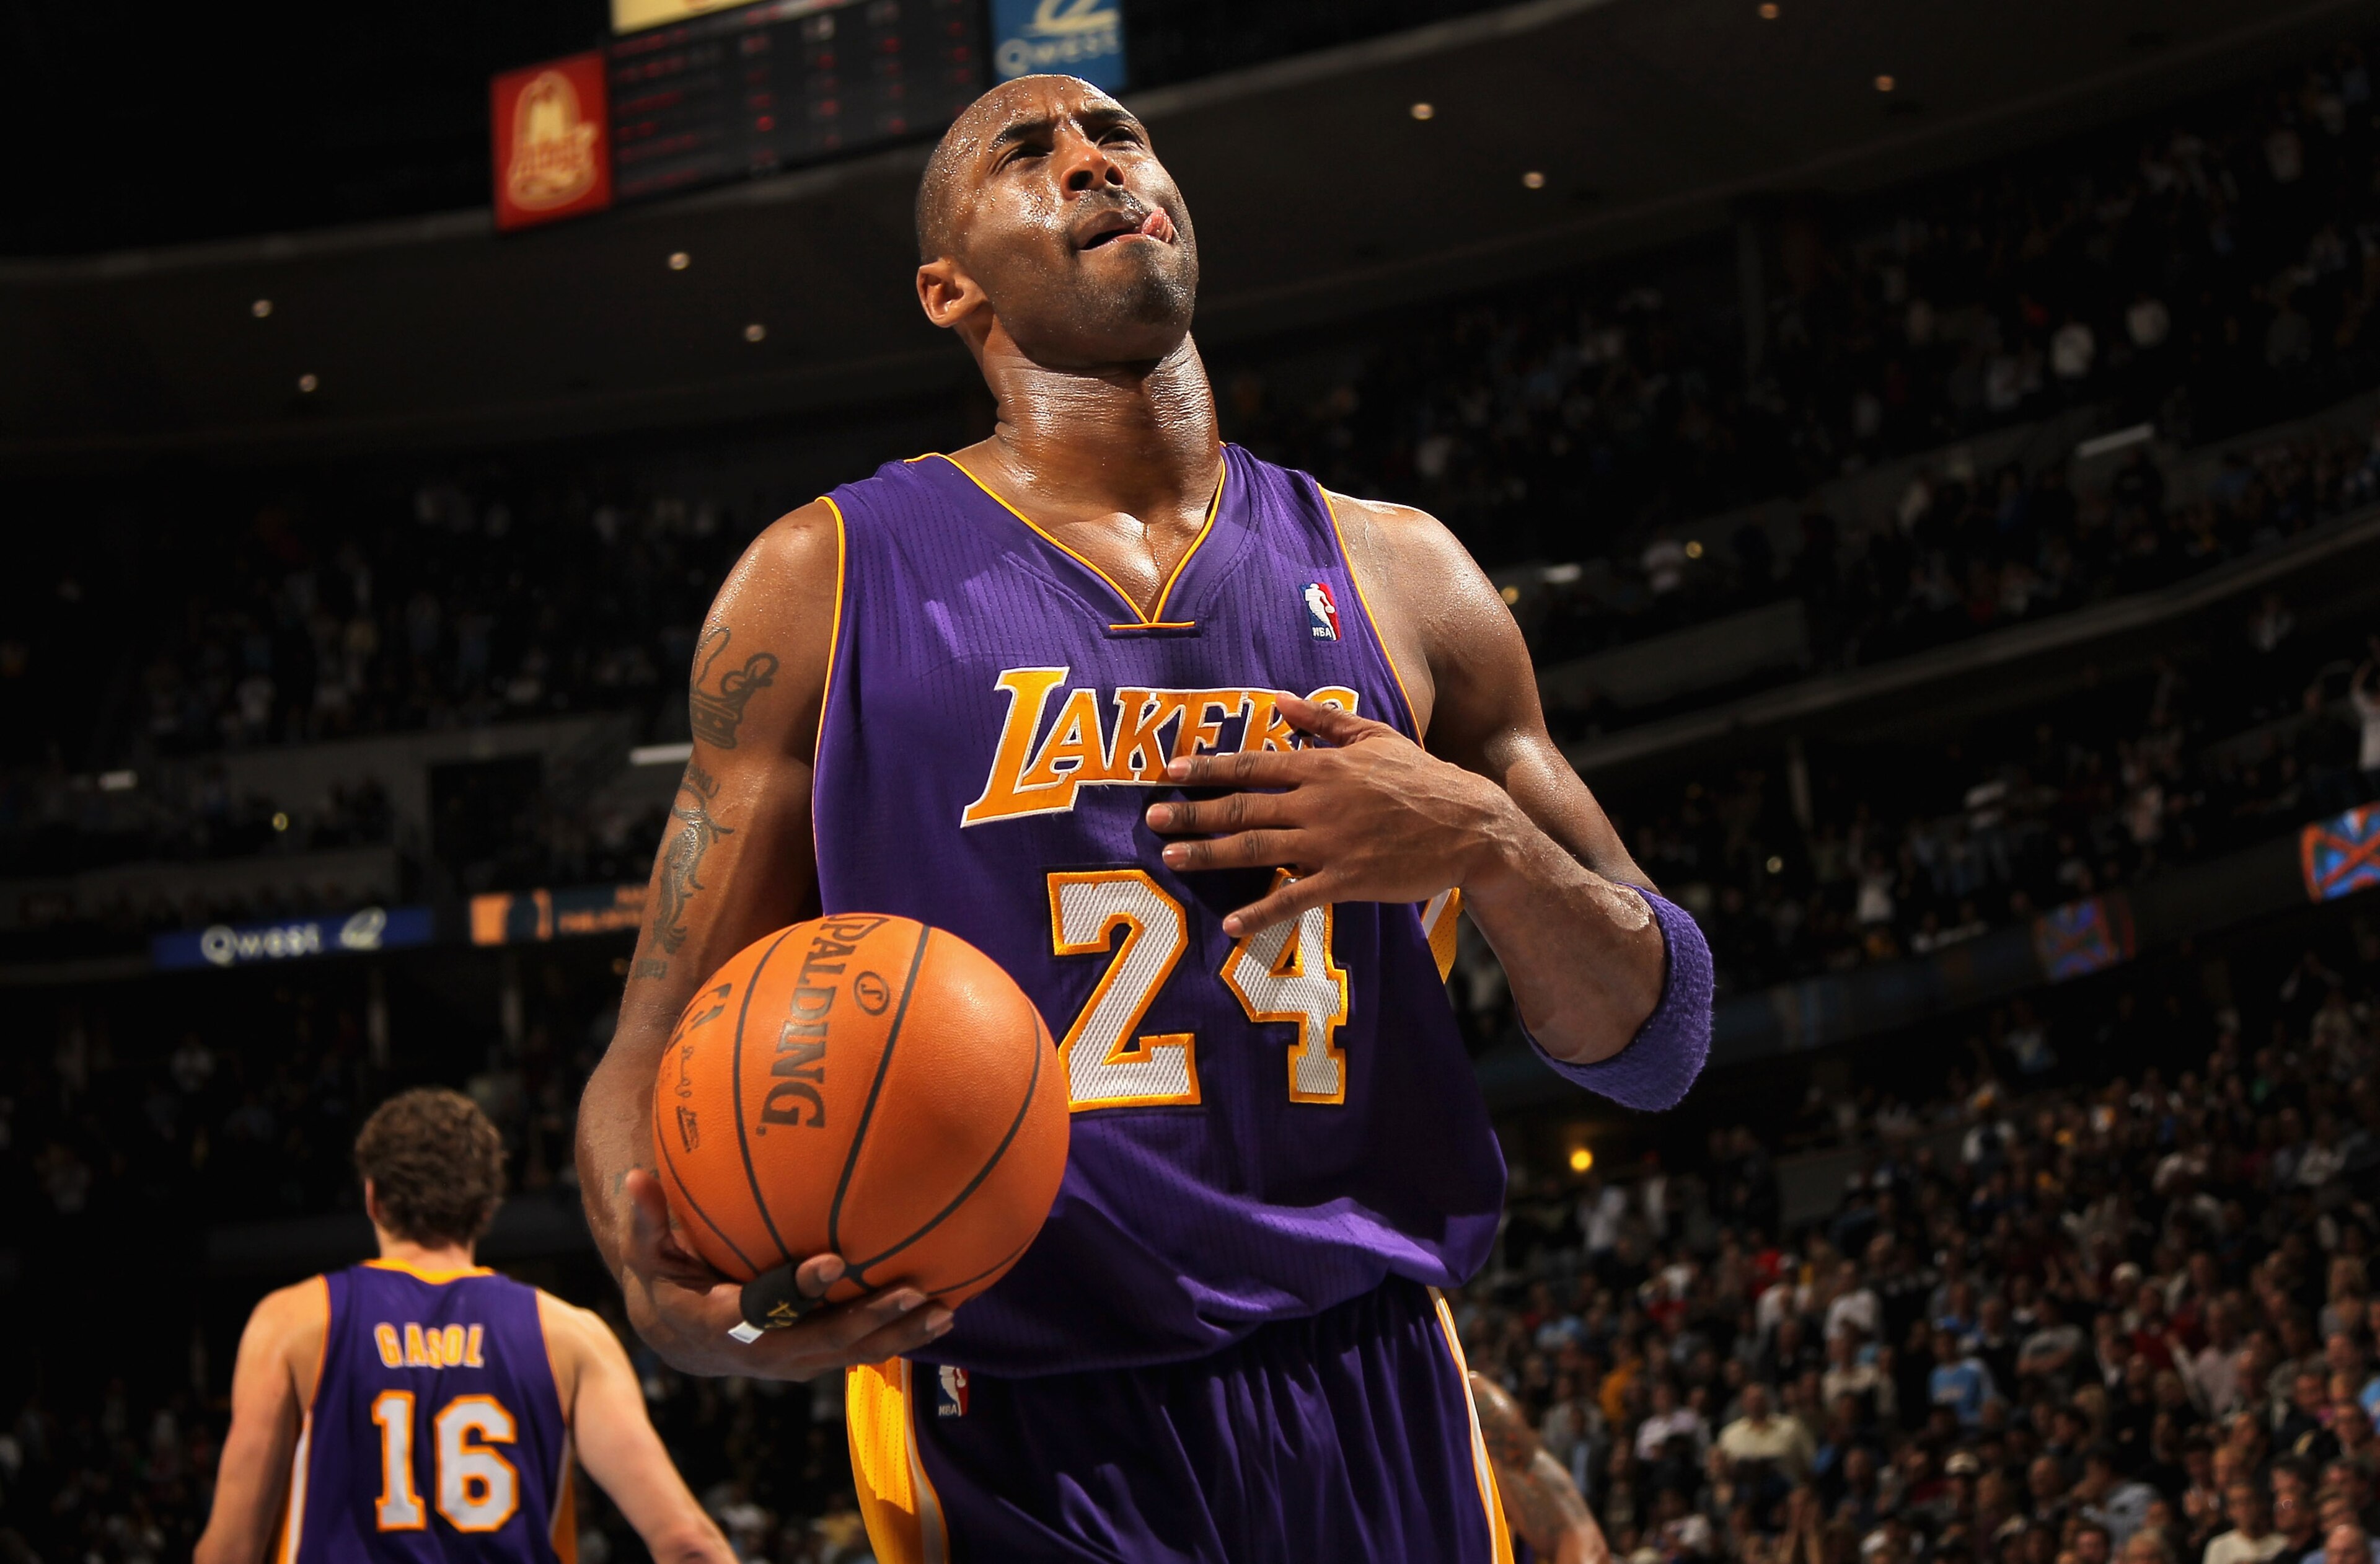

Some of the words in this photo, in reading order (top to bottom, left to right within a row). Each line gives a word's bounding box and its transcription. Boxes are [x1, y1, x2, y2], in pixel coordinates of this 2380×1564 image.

[1312, 626, 1332, 638] NBA
[1047, 868, 1349, 1114] 24
[374, 1322, 485, 1369] GASOL
[938, 1403, 958, 1417] NBA
[371, 1389, 520, 1533] 16
